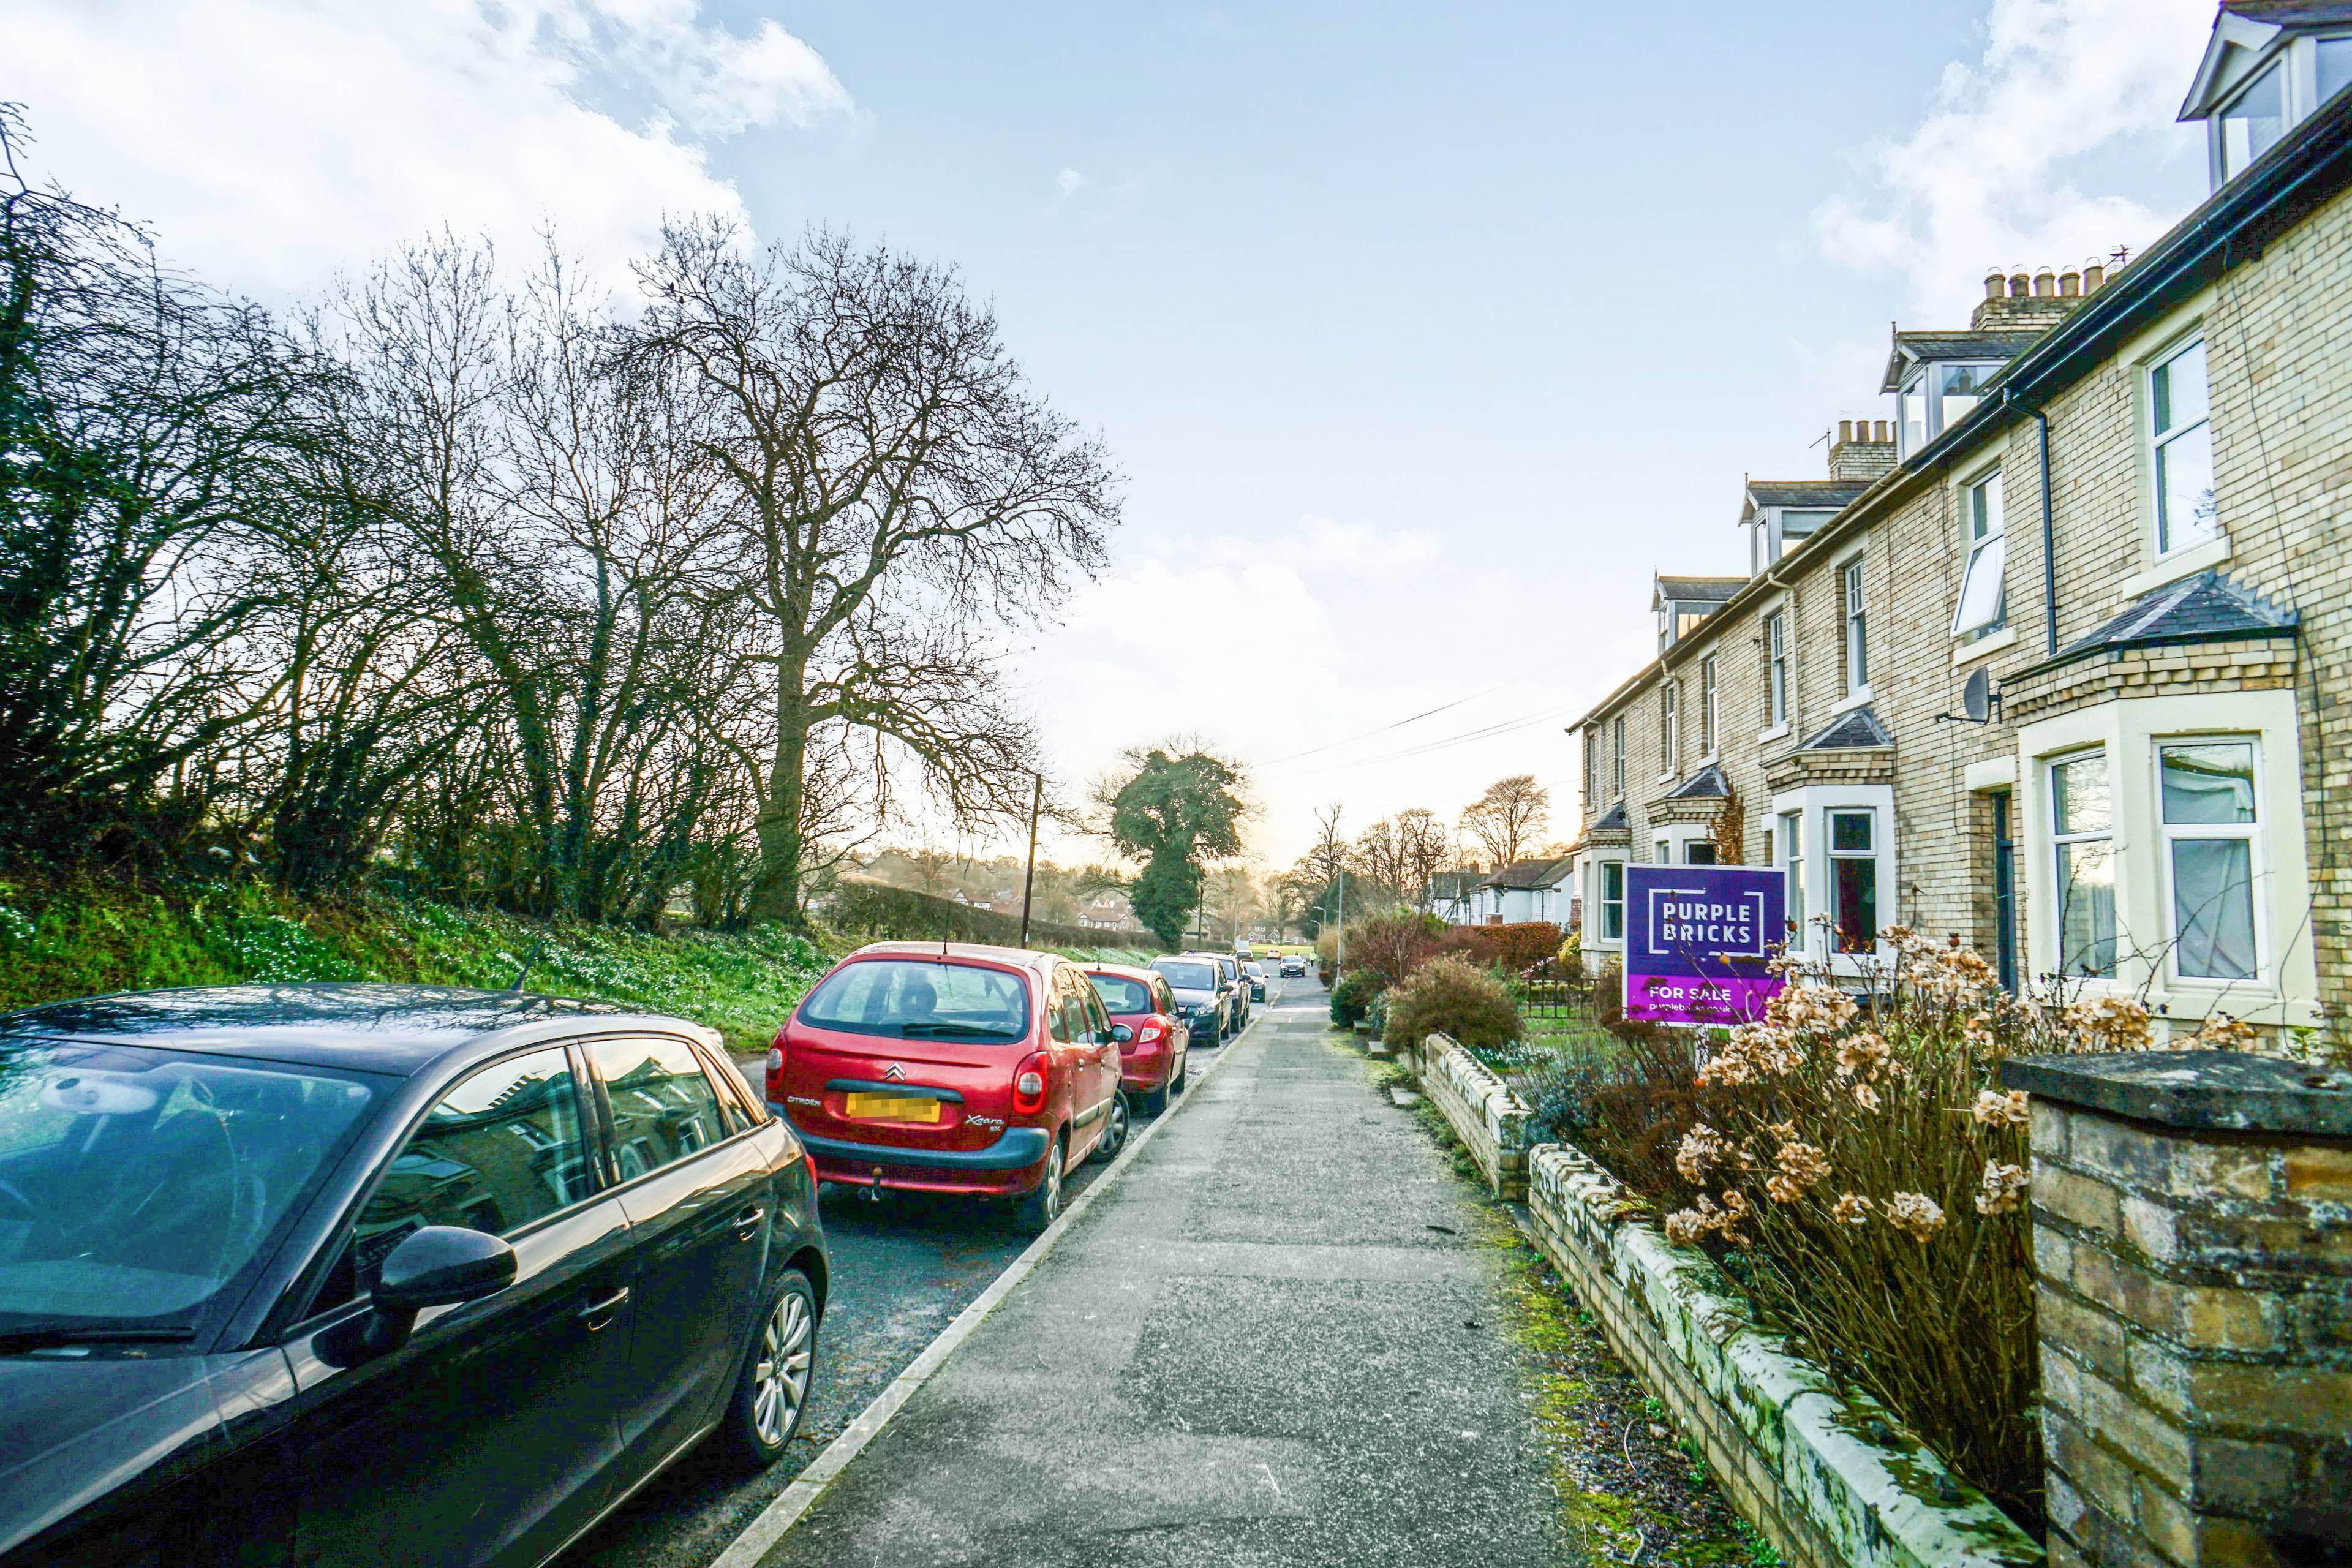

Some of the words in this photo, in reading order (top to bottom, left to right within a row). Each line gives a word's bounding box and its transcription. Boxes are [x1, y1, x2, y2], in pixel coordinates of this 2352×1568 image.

[1663, 903, 1750, 922] PURPLE
[1663, 924, 1750, 943] BRICKS
[1649, 986, 1683, 999] FOR
[1689, 988, 1732, 1001] SALE
